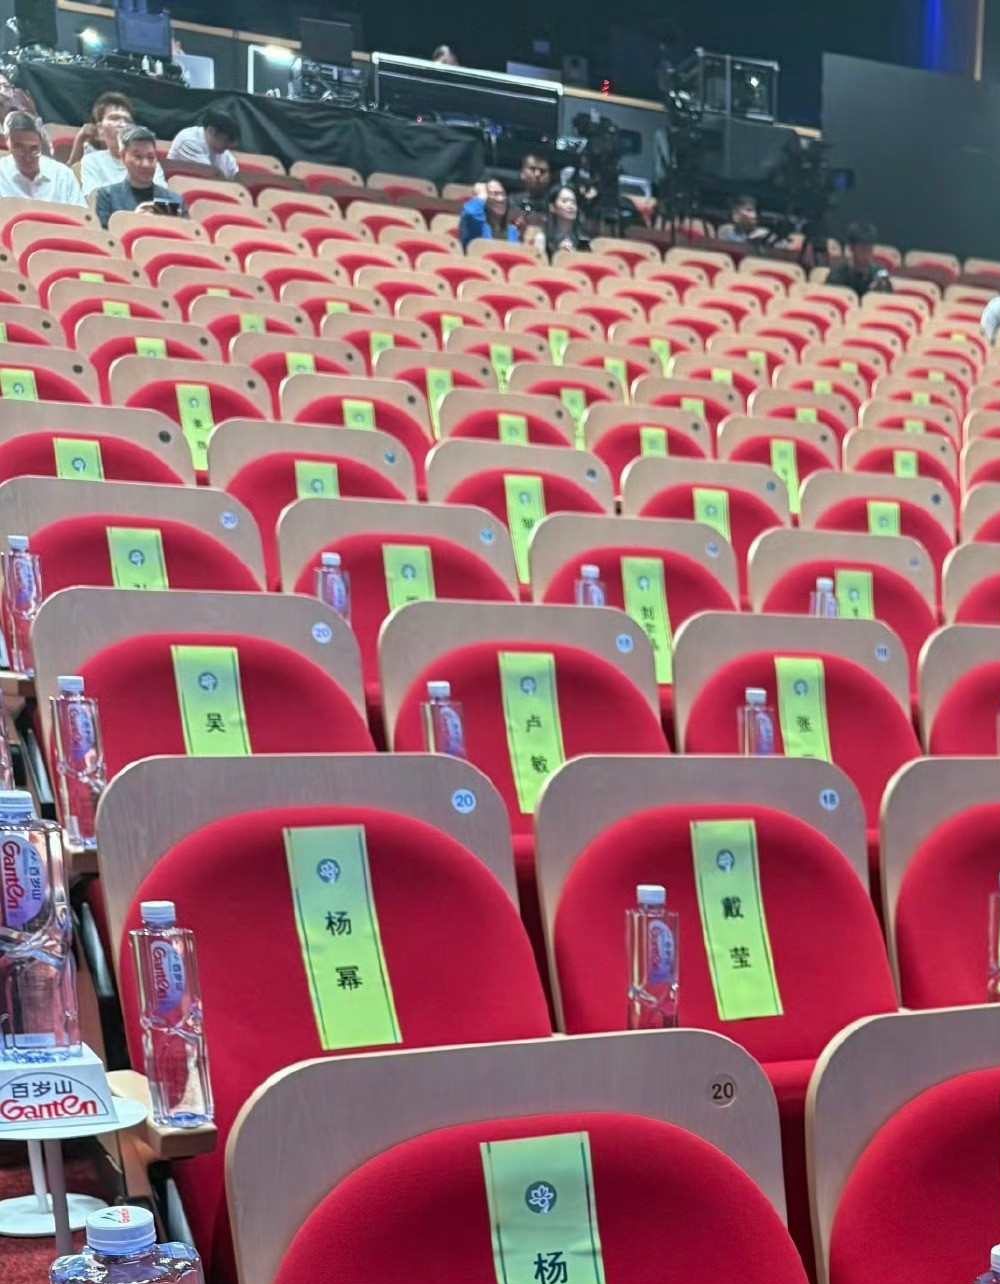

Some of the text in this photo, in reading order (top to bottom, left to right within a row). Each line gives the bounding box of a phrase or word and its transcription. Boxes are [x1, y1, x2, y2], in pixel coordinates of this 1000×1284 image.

[205, 712, 226, 733] 吴
[525, 714, 549, 774] 卢敏
[454, 795, 473, 808] 20
[721, 895, 752, 970] 戴莹
[324, 910, 363, 991] 杨幂
[11, 1079, 73, 1099] 百岁山
[711, 1082, 734, 1100] 20
[0, 1094, 98, 1121] Ganten
